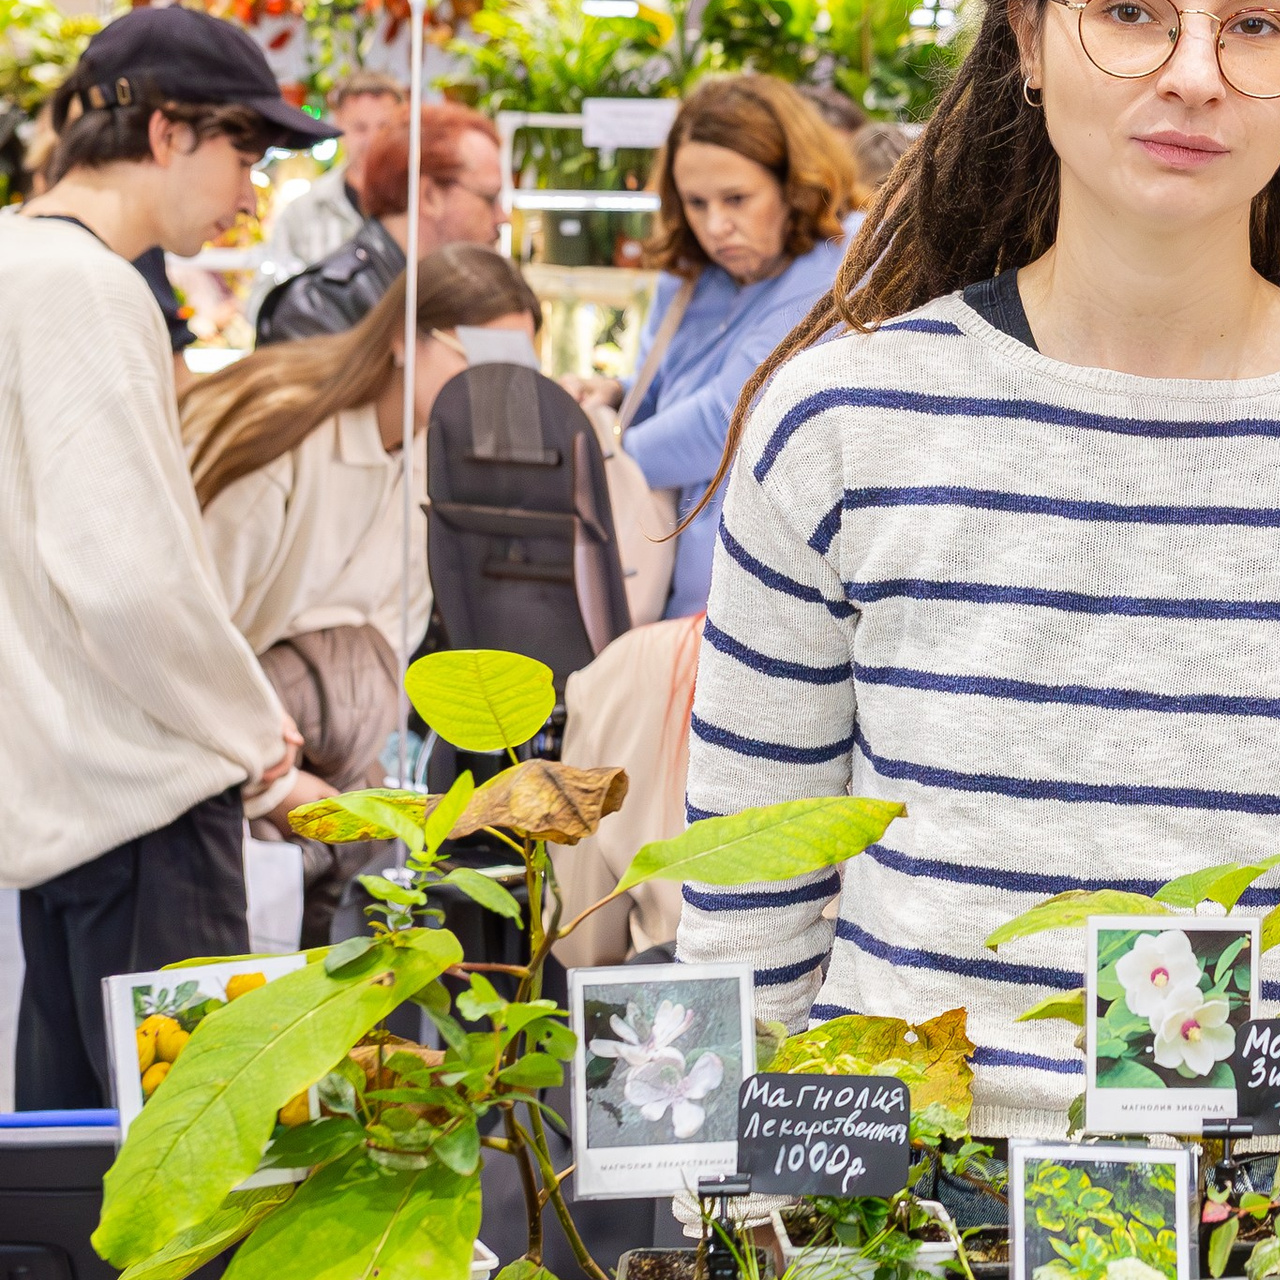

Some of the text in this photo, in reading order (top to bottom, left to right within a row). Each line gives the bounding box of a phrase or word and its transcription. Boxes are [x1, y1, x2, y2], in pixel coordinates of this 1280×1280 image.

[741, 1076, 905, 1114] Магнолия
[1121, 1103, 1225, 1113] МАГНОЛИЯ ЗИБОЛЬДА
[743, 1109, 908, 1147] Лекарственная
